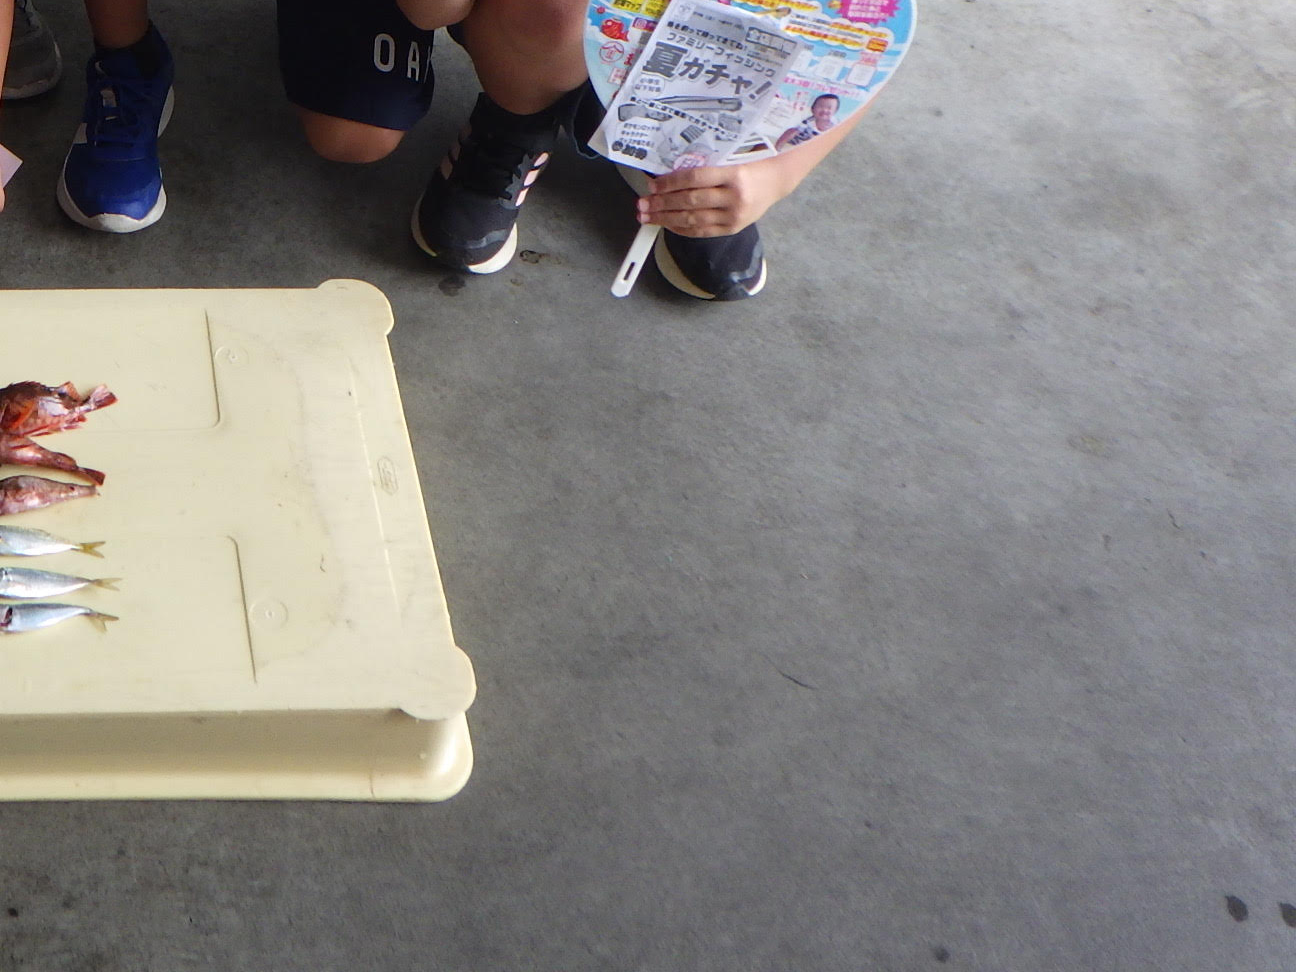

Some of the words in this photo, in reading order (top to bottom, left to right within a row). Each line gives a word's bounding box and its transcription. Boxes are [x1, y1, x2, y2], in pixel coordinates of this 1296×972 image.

[373, 33, 432, 84] OA
[642, 41, 772, 99] 夏ガチャ!
